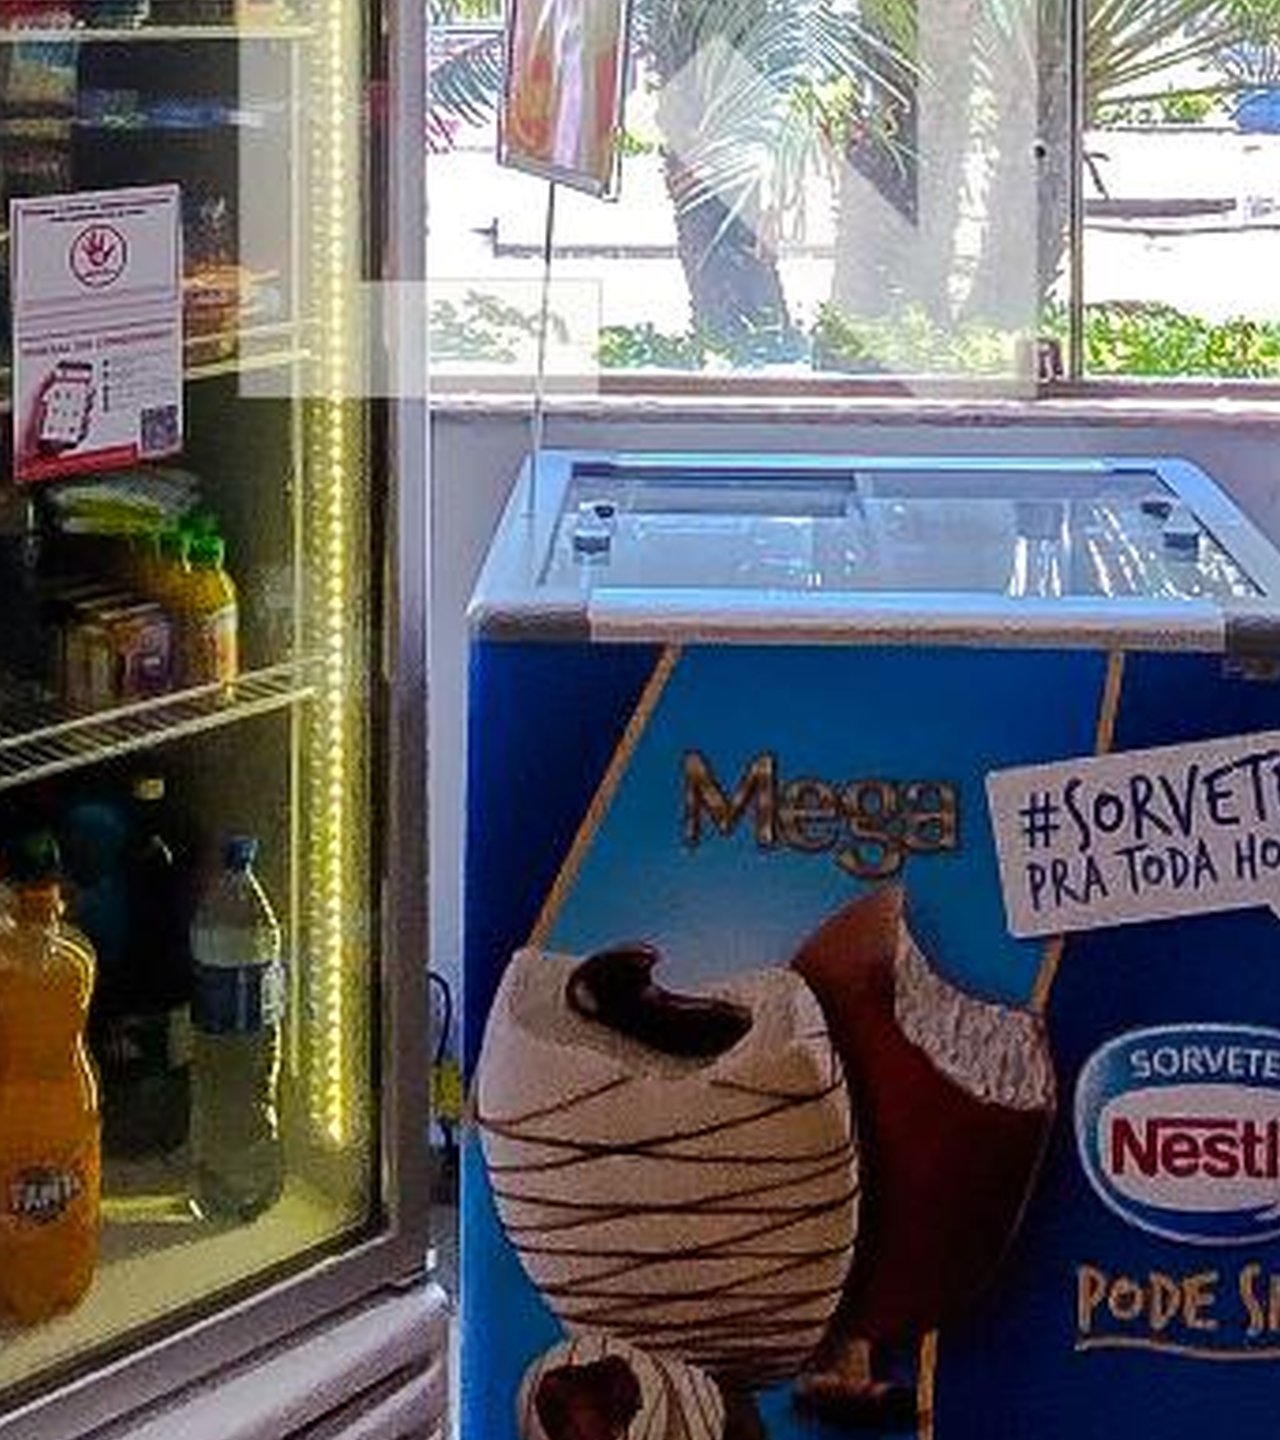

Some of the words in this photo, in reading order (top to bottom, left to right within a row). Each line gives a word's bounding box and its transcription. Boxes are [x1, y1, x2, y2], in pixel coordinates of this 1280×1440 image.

[683, 748, 957, 877] Mega
[1027, 856, 1109, 911] PRA
[1114, 838, 1219, 894] TODA
[1077, 1262, 1219, 1337] PODE
